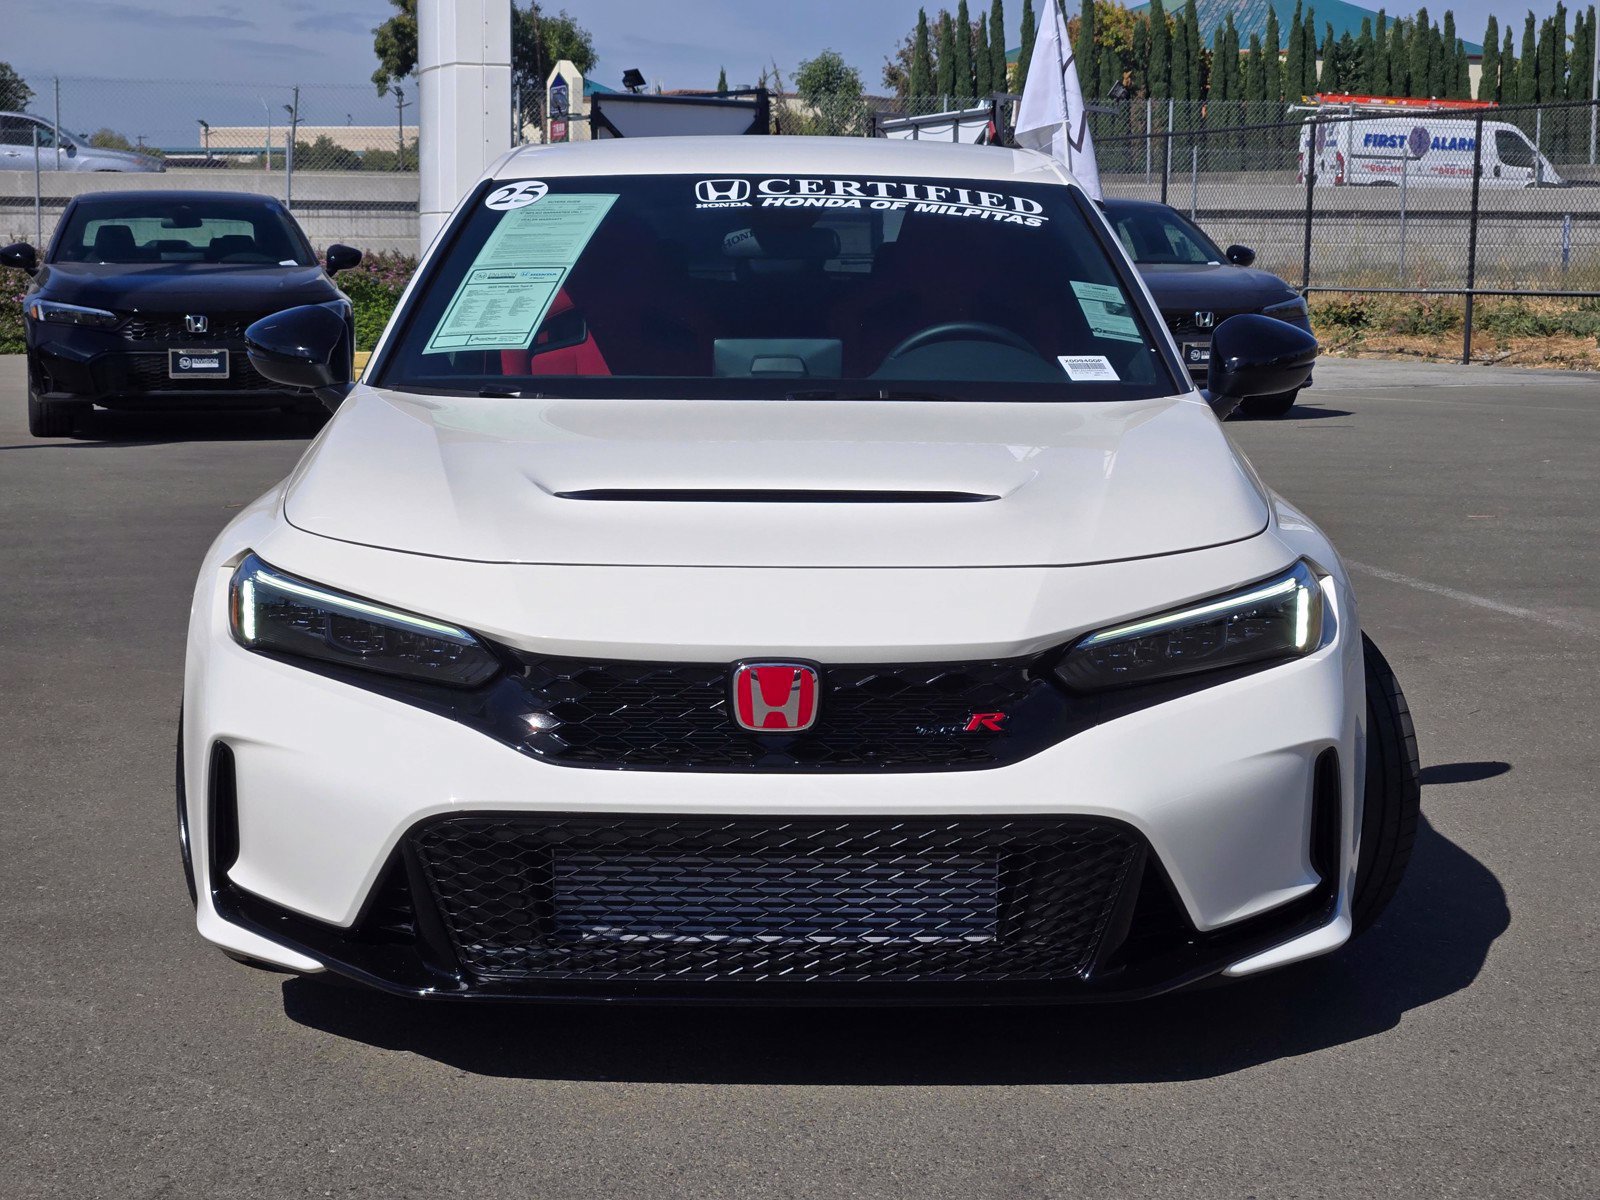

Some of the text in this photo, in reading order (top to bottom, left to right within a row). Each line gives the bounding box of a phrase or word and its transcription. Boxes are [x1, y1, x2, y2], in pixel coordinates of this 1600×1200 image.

[1364, 133, 1407, 149] FIRST
[489, 184, 545, 206] 25
[758, 178, 1043, 215] CERTIFIED
[761, 198, 1043, 227] HONDA OF MILPITAS
